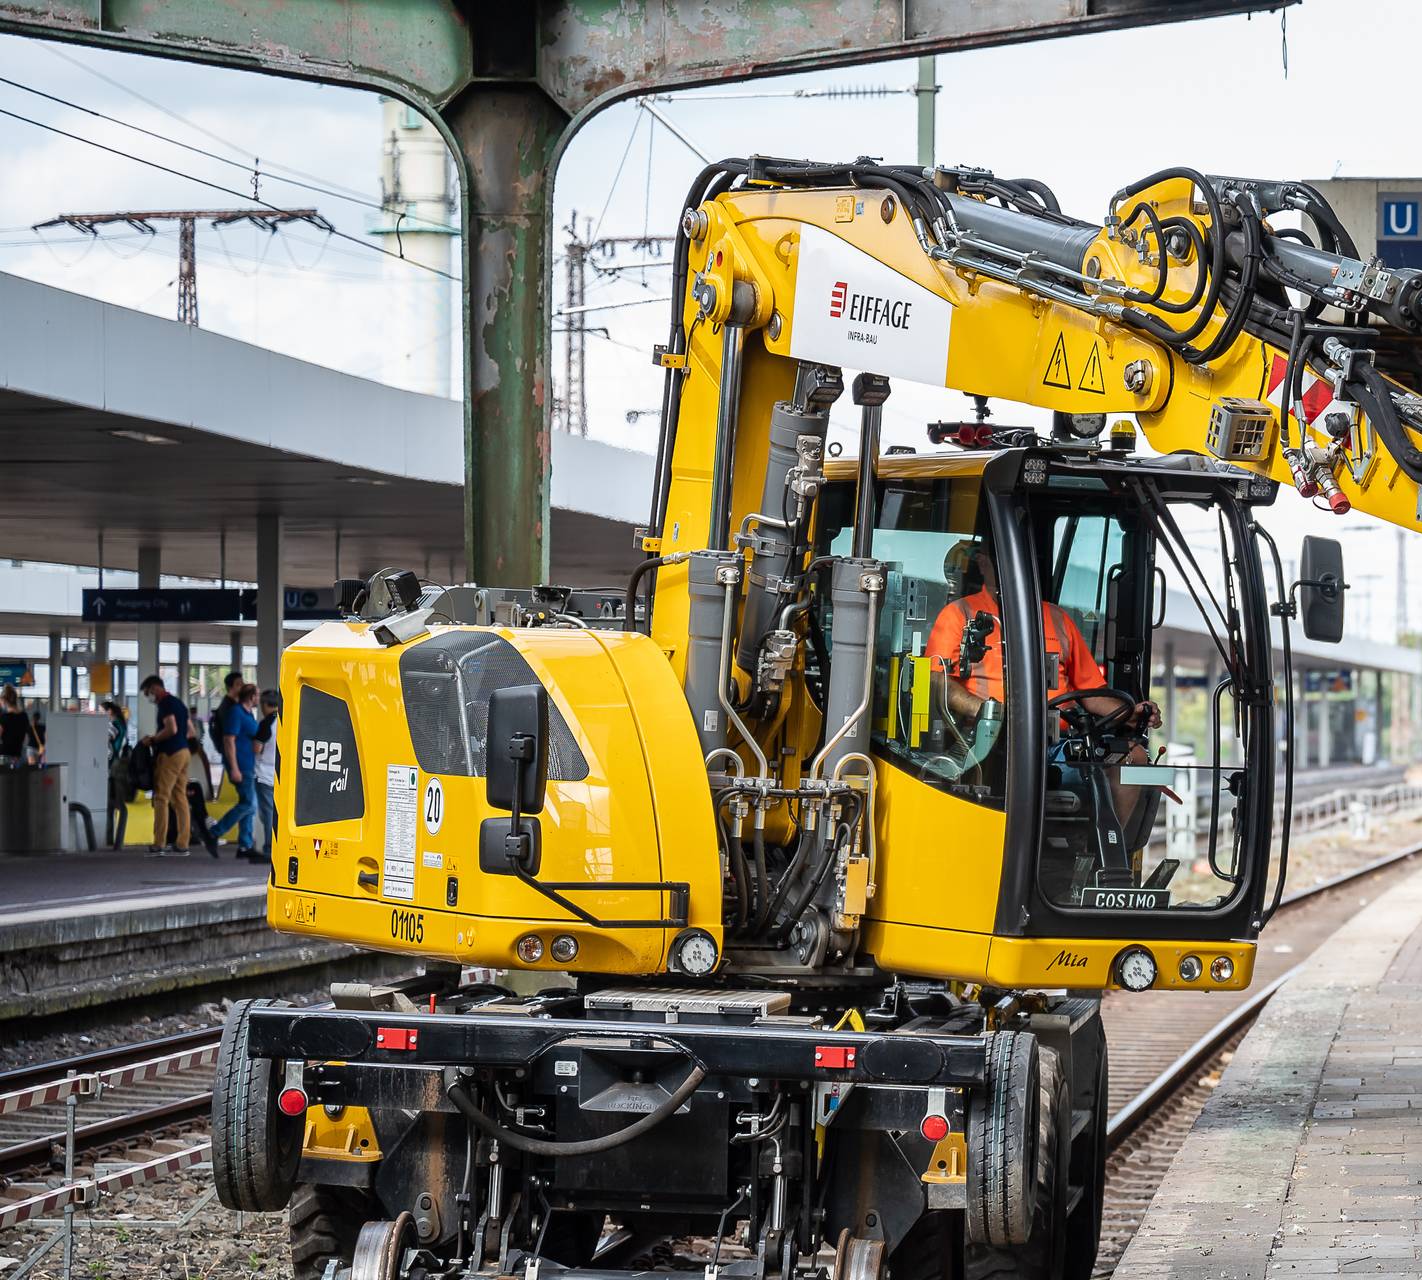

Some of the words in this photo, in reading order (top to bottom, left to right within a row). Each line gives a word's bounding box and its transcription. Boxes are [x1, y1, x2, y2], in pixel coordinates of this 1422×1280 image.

[1390, 204, 1412, 234] U
[849, 293, 913, 330] EIFFAGE
[847, 330, 878, 345] INFRA-BAU
[301, 739, 342, 773] 922
[329, 767, 349, 793] rail
[426, 786, 441, 823] 20
[1095, 892, 1156, 909] COSIMO
[391, 909, 424, 943] 01105
[1046, 949, 1088, 971] Mia
